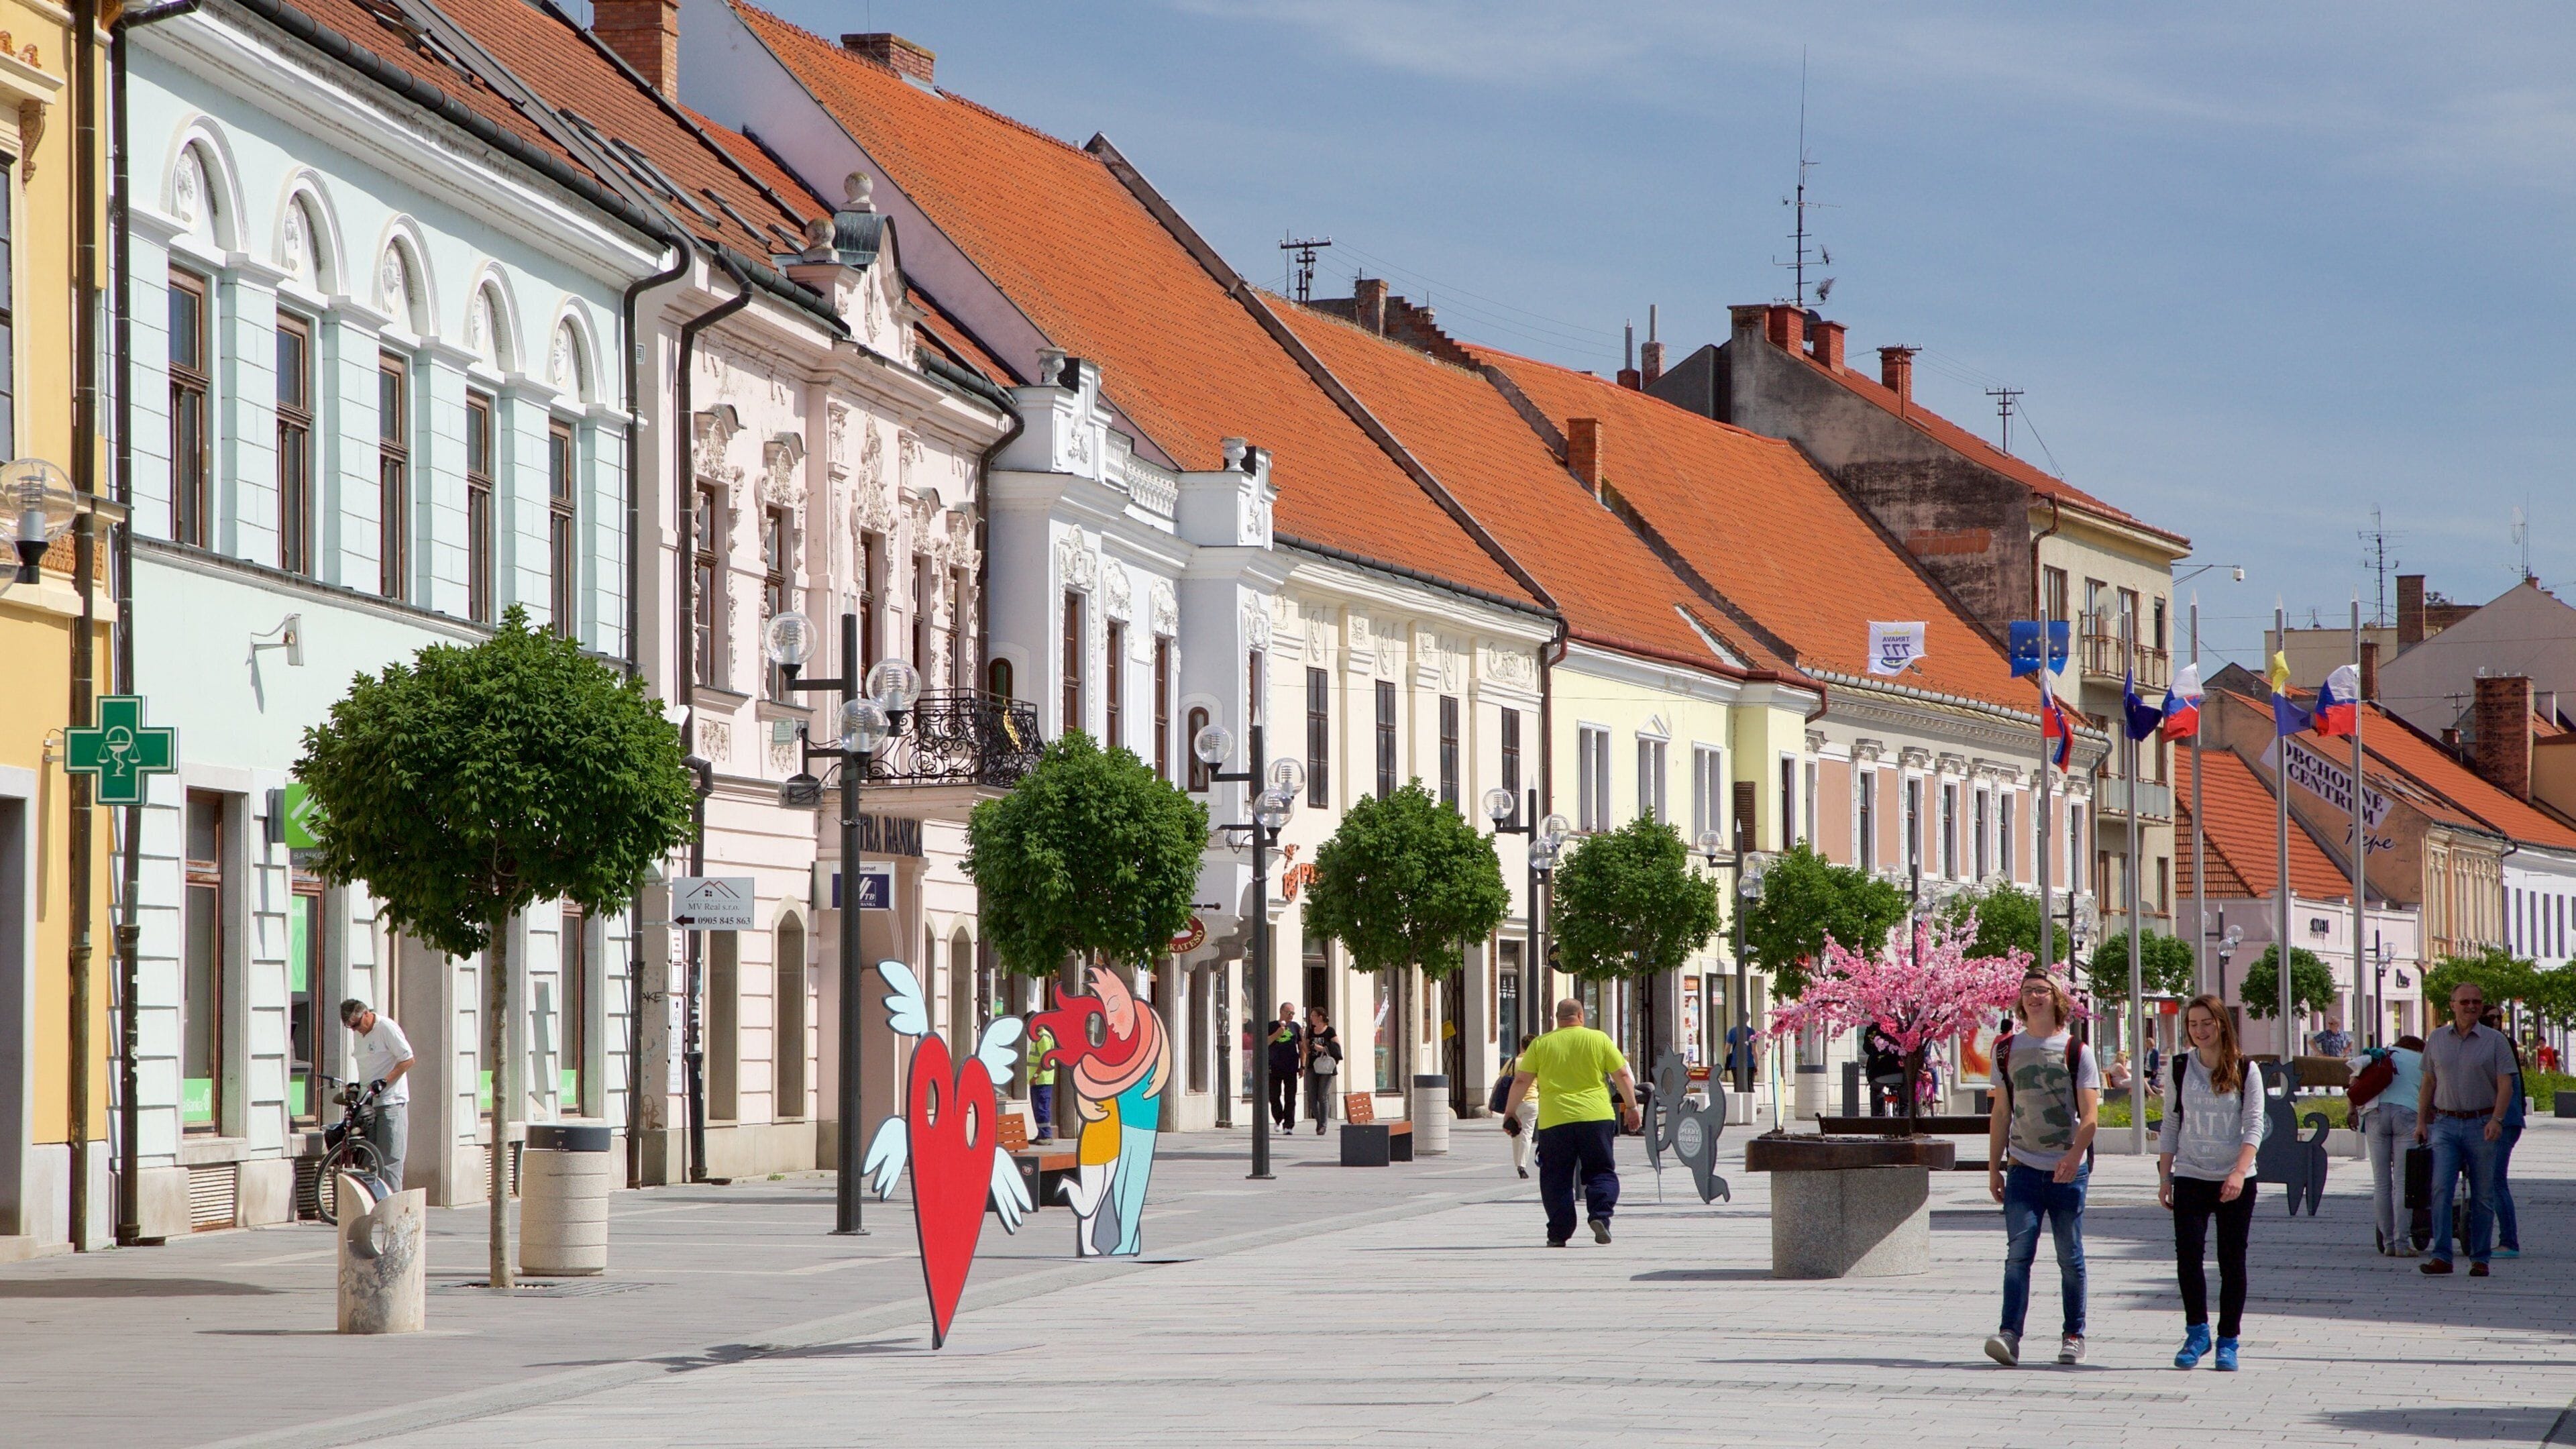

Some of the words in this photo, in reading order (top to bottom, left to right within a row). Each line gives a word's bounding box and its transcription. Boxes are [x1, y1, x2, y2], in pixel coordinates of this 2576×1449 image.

[2286, 741, 2383, 812] BCHONÉ
[2288, 763, 2373, 824] CENTRM
[859, 814, 882, 853] TRA
[884, 816, 923, 857] BANKA
[2184, 1110, 2235, 1136] CITY
